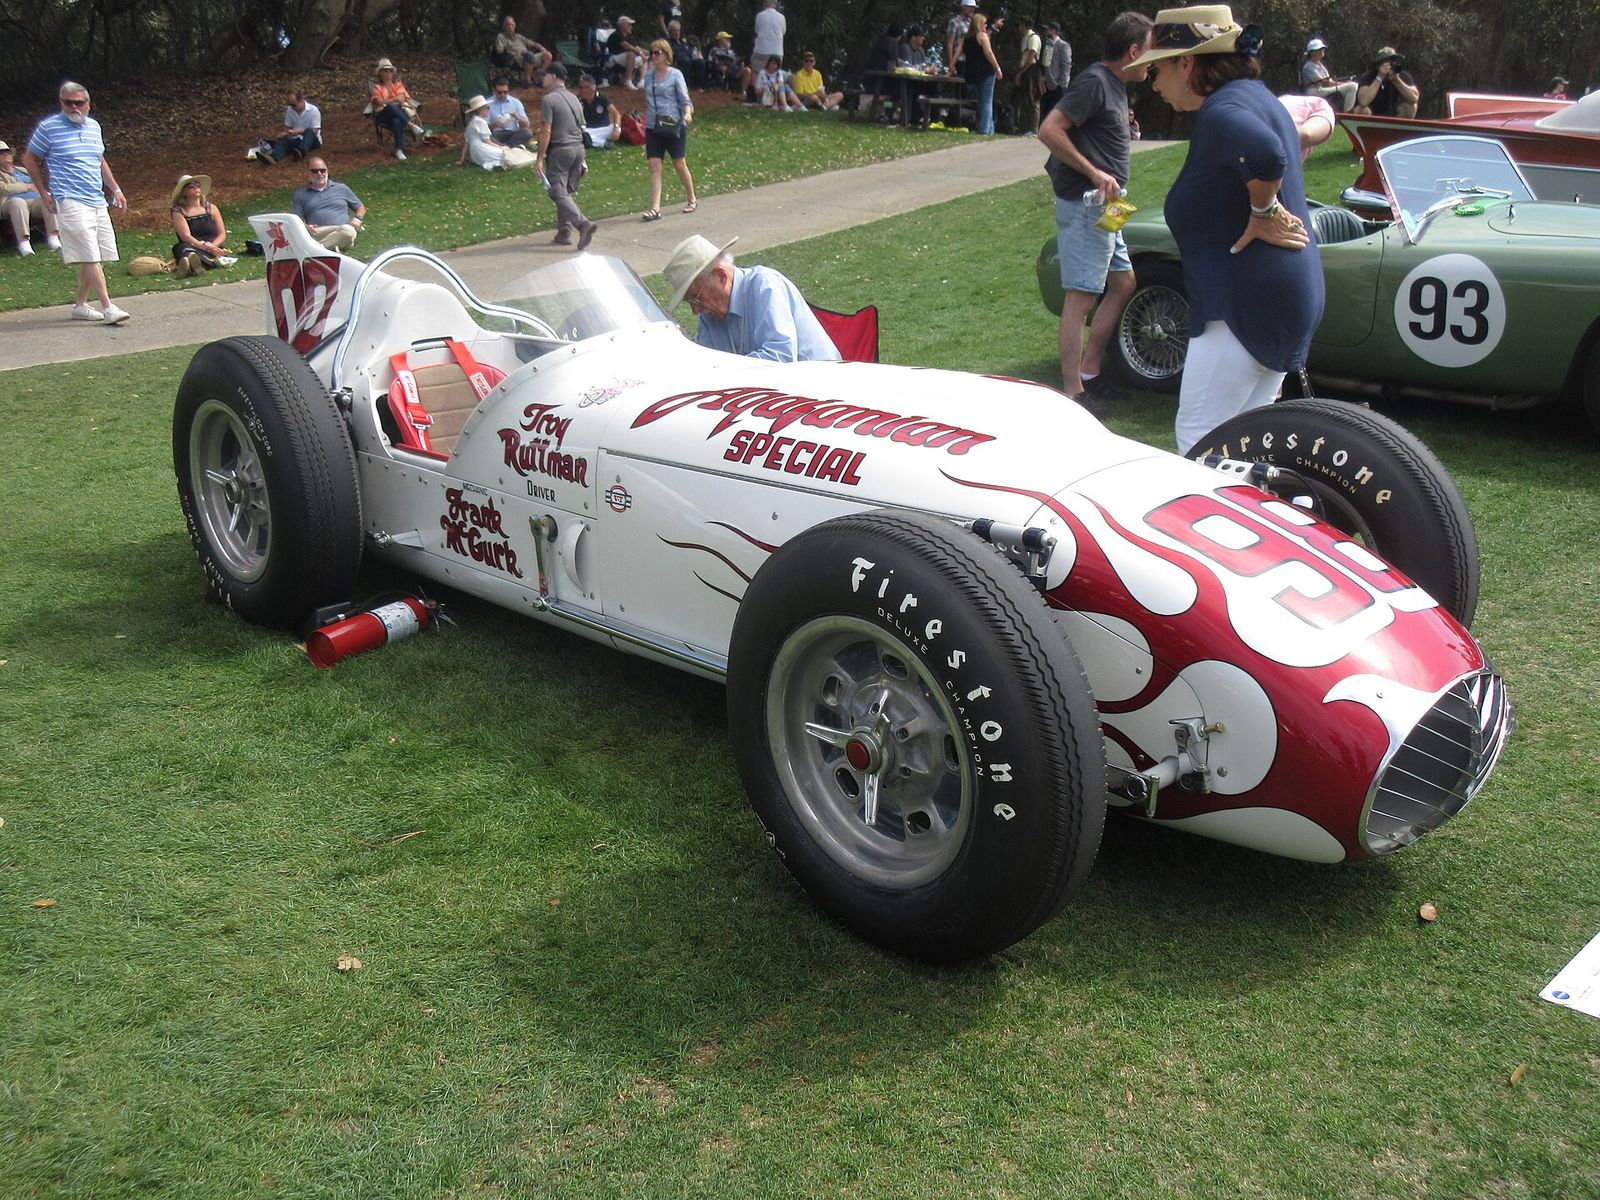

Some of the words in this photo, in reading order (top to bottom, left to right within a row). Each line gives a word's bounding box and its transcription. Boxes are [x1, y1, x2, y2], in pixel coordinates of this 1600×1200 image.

[1409, 276, 1490, 345] 93
[262, 435, 273, 456] CORD
[519, 403, 573, 450] Troy
[497, 428, 590, 488] Ruttman
[723, 429, 866, 486] SPECIAL
[1296, 456, 1357, 494] CHAMPION
[445, 488, 510, 538] Frank
[527, 480, 556, 502] DRIVER
[440, 515, 523, 578] McGurk
[1142, 485, 1418, 630] 98
[851, 557, 1016, 821] Firestone
[877, 607, 928, 655] DELUXE
[946, 680, 984, 777] CHAMPION
